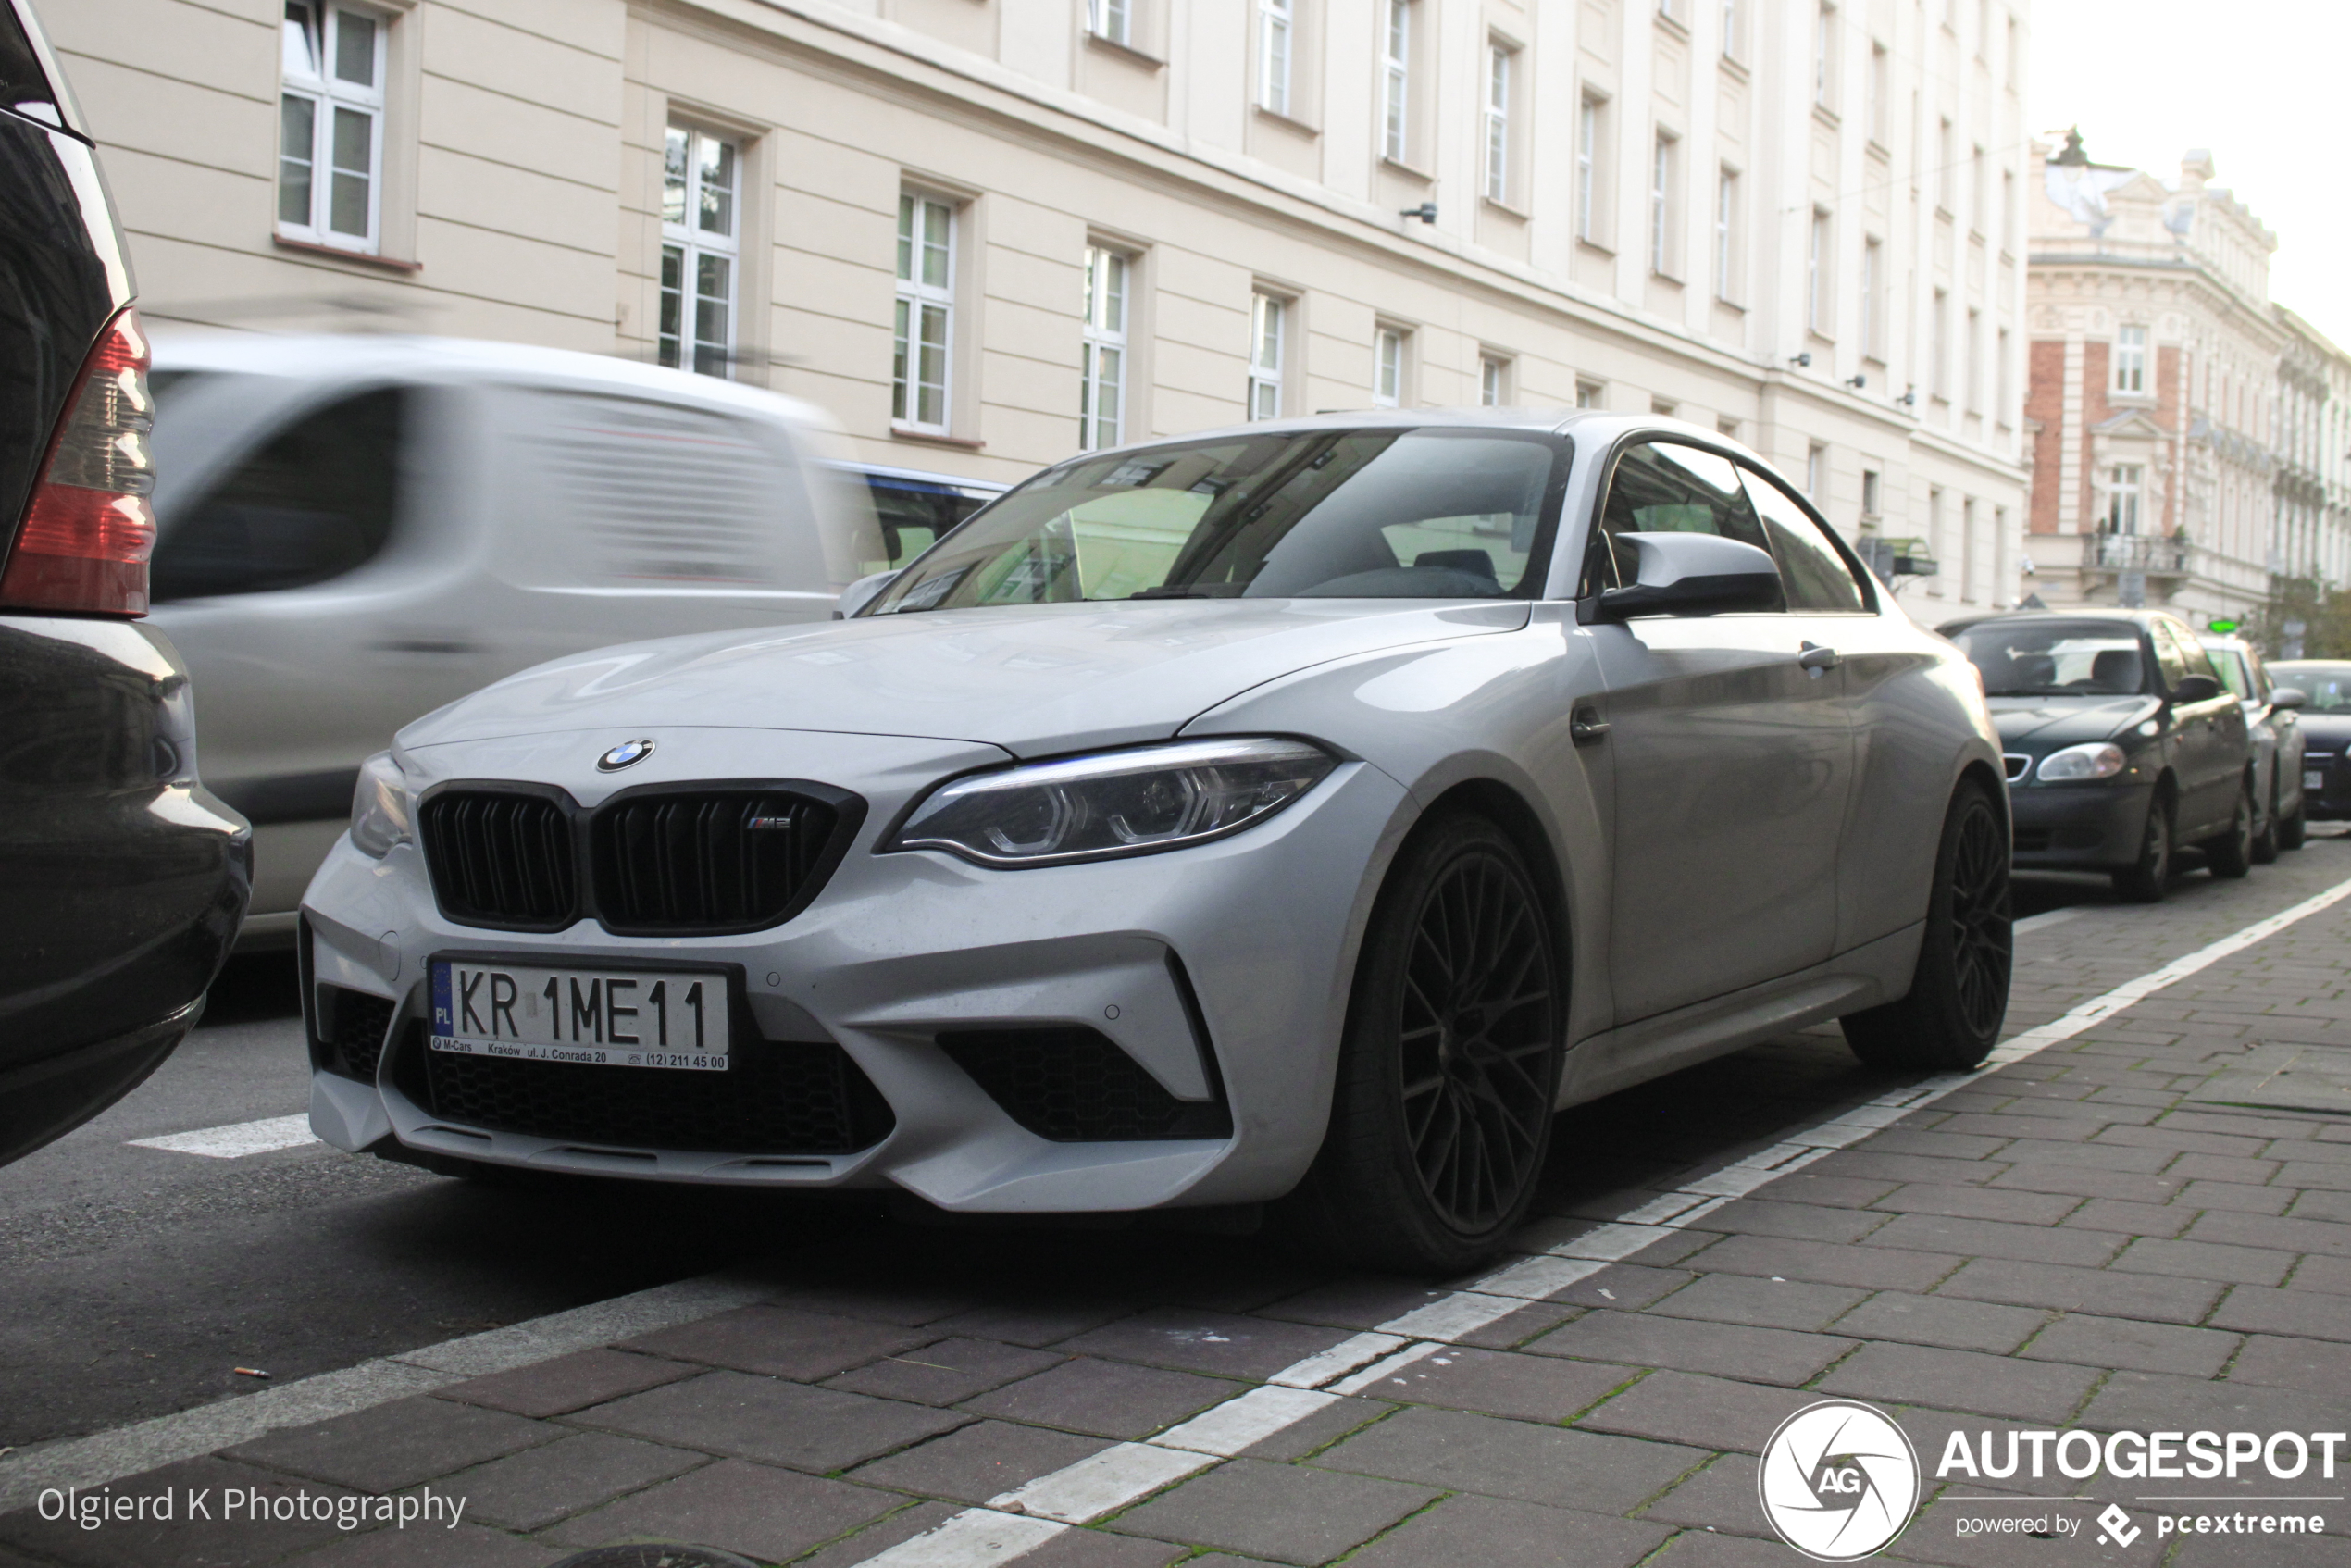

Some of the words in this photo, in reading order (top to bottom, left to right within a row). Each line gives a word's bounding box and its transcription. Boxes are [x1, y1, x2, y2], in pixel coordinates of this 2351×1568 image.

[435, 1007, 451, 1024] PL
[460, 970, 519, 1037] KR
[543, 976, 704, 1047] 1ME11
[443, 1039, 472, 1052] M-Cars
[488, 1043, 521, 1056] Kraków
[528, 1048, 539, 1058] ul.
[541, 1049, 549, 1059] J.
[552, 1049, 592, 1062] Conrada
[595, 1052, 606, 1063] 20
[646, 1052, 667, 1065] (12)
[670, 1054, 690, 1066] 211
[693, 1055, 707, 1067] 45
[711, 1056, 724, 1068] 00
